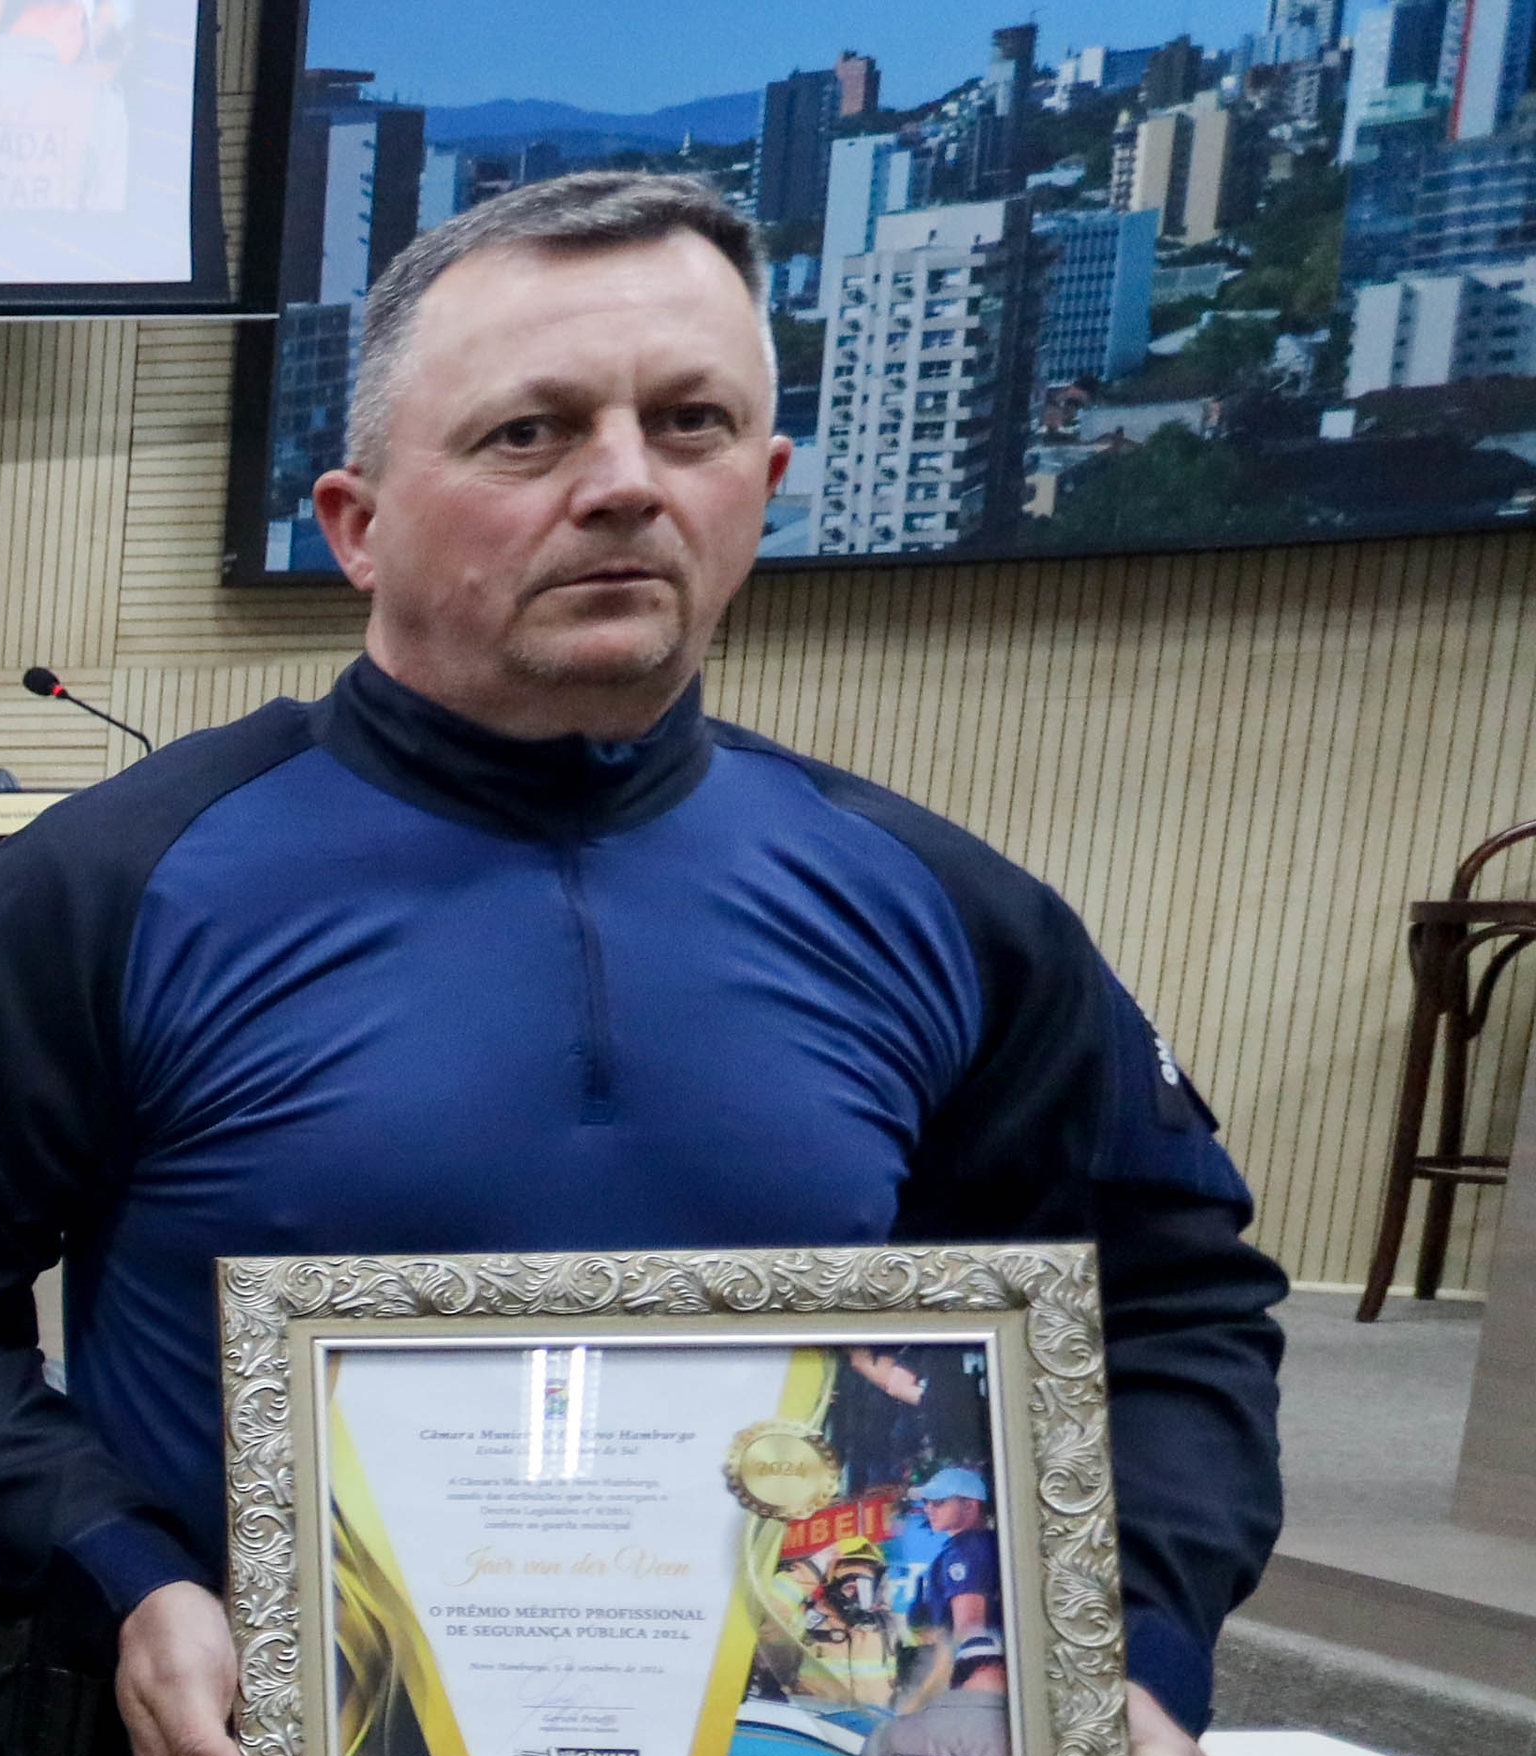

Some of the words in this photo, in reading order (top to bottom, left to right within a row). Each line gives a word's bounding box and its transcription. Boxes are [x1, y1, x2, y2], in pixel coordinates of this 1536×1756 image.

[429, 1607, 442, 1617] O
[446, 1603, 510, 1618] PRÊMIO
[515, 1604, 580, 1619] MÉRITO
[585, 1608, 706, 1620] PROFISSIONAL
[446, 1625, 466, 1637] DE
[472, 1626, 572, 1641] SEGURANÇA
[577, 1625, 647, 1638] PÚBLICA
[652, 1630, 691, 1640] 2024
